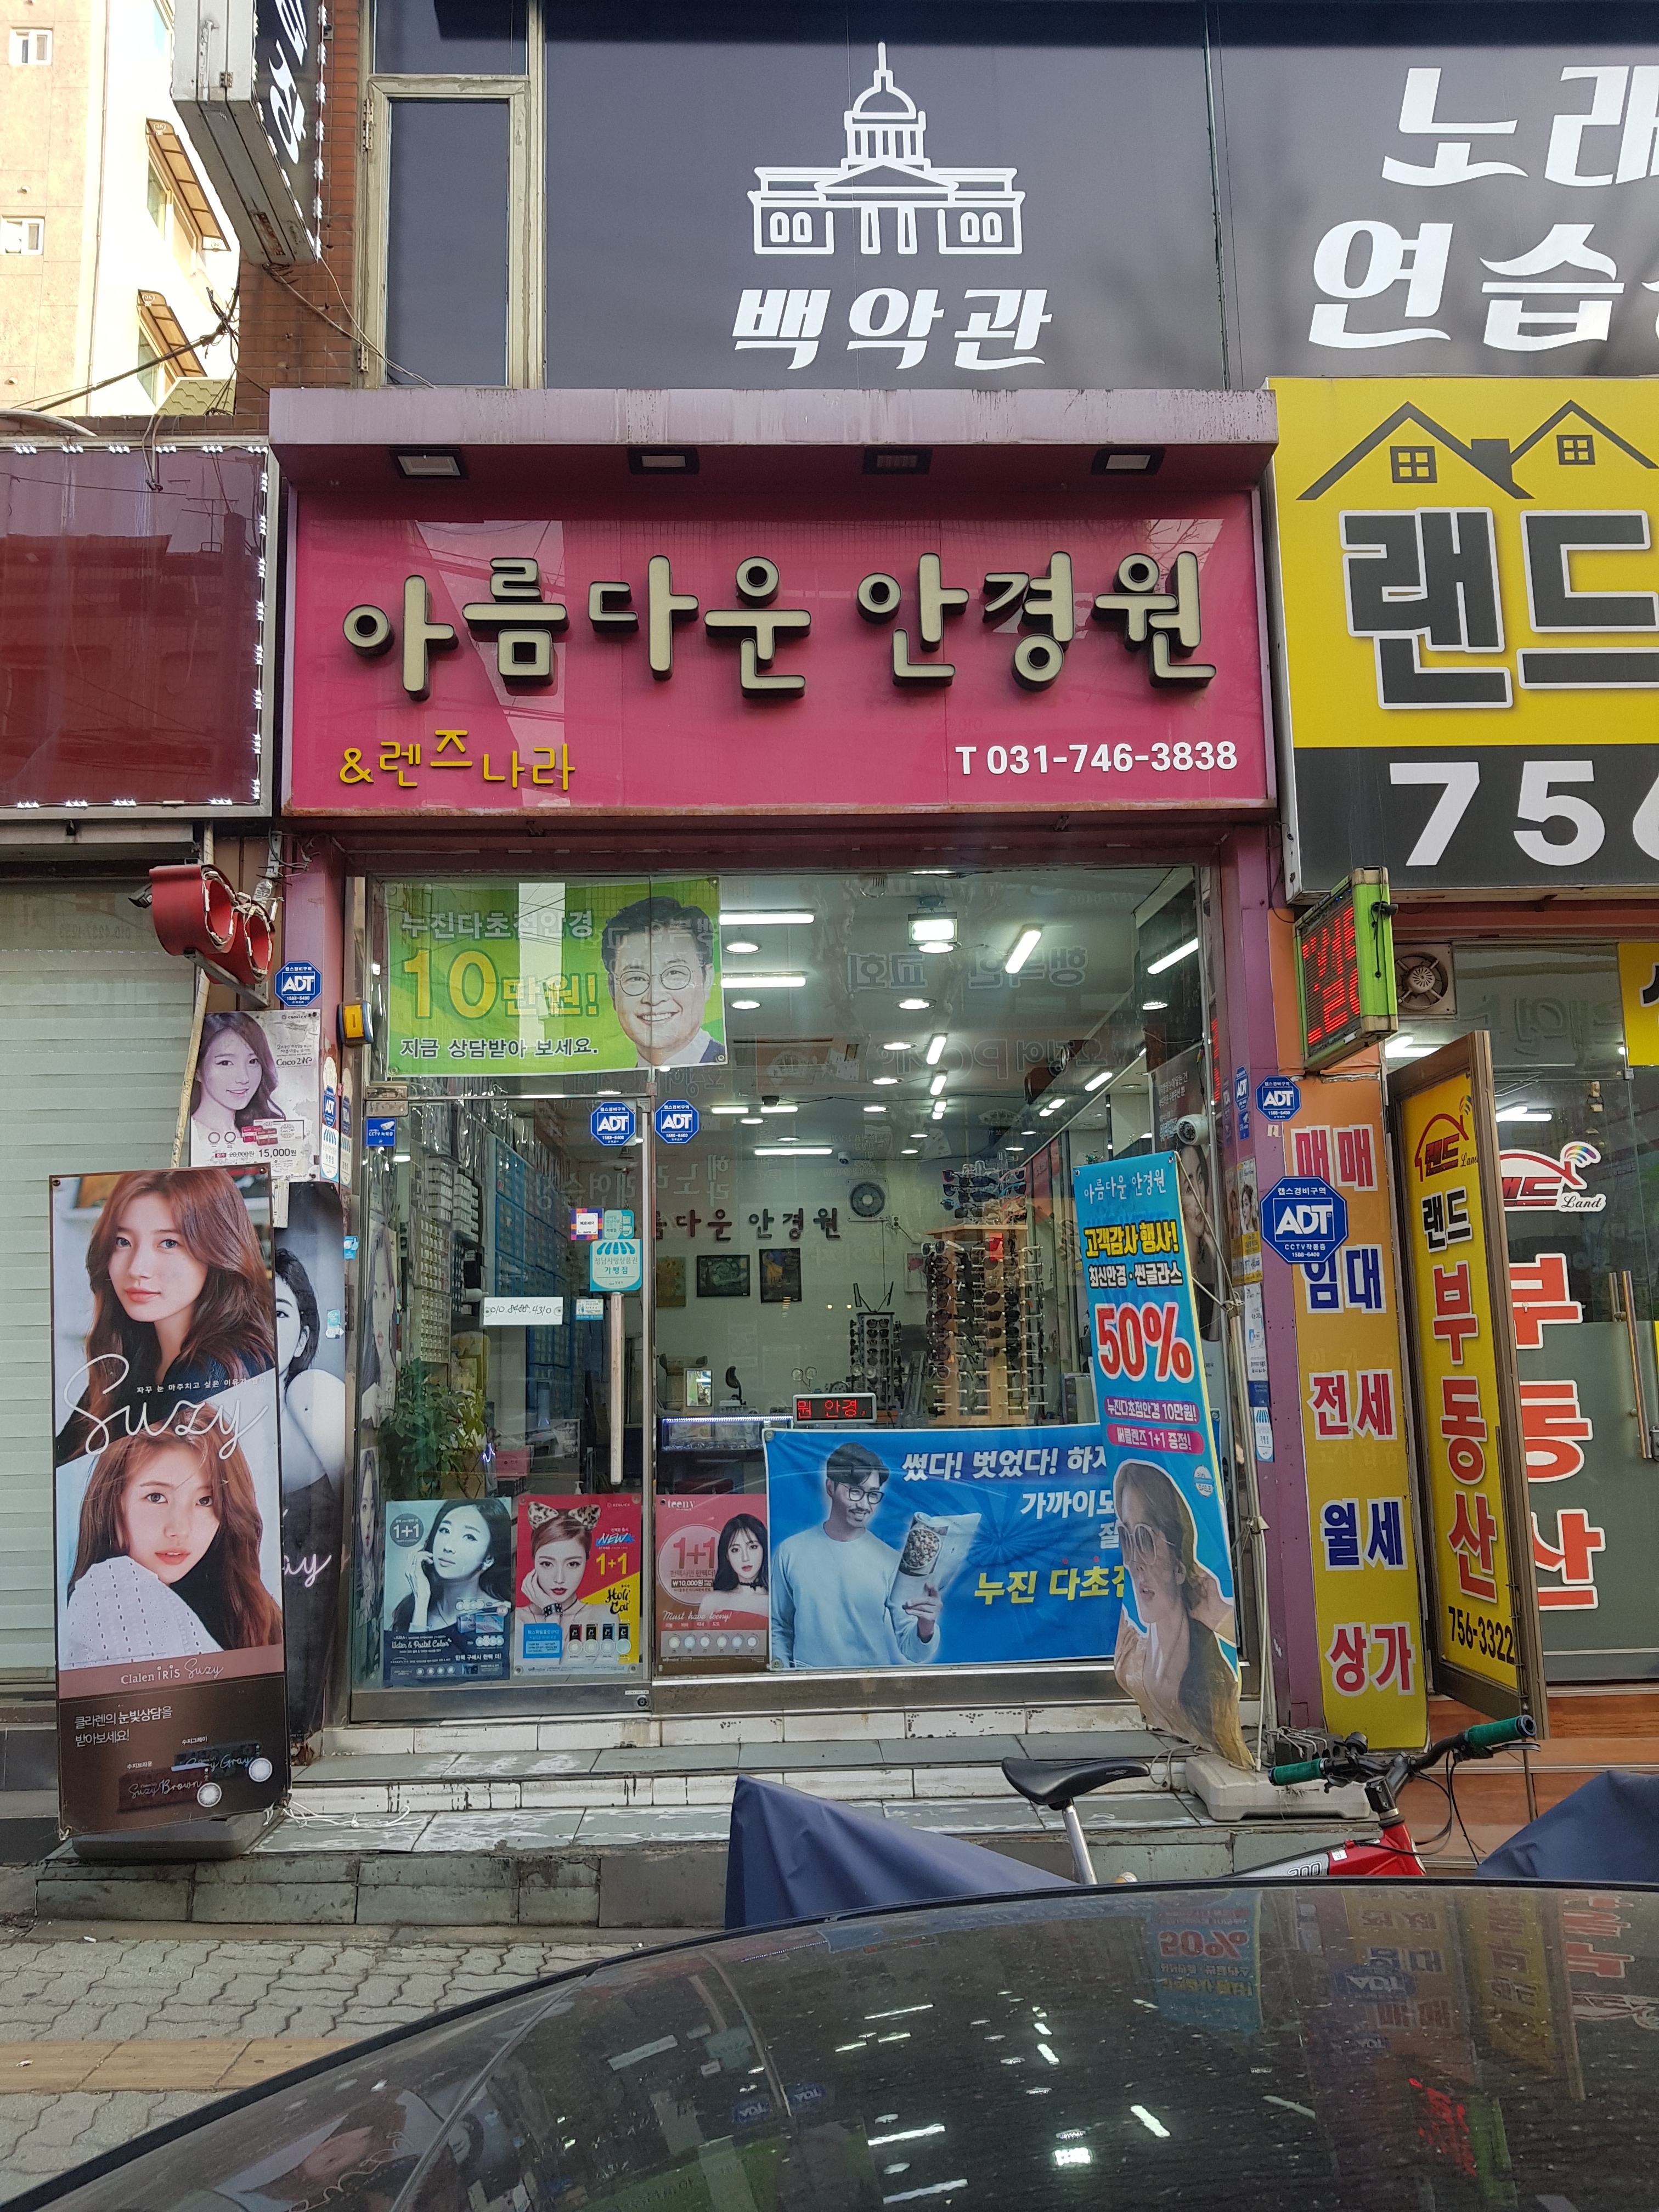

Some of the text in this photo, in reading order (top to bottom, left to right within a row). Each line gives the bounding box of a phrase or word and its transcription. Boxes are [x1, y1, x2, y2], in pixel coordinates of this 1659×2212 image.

[1309, 220, 1659, 352] 연습
[732, 288, 1053, 370] 백악관
[1339, 506, 1659, 708] 랜드
[343, 551, 1217, 701] 아름다운 안경원
[955, 741, 1238, 775] T 031-746-3838
[283, 975, 314, 992] ADT
[403, 950, 599, 1019] 10만원!
[401, 1037, 599, 1058] 지금 상담받아 보세요.
[1236, 1078, 1247, 1099] ADT
[1263, 1090, 1293, 1107] ADT
[598, 1115, 629, 1131] ADT
[662, 1114, 692, 1129] ADT
[258, 1148, 297, 1158] 15,000원
[1293, 1125, 1376, 1190] 매매
[1425, 1133, 1460, 1177] 랜드
[1084, 1168, 1166, 1205] 아름다운 안경원
[1278, 1187, 1326, 1195] 캡스경비구역
[1561, 1195, 1602, 1209] Land
[748, 1207, 841, 1240] 안경원
[1276, 1205, 1333, 1234] ADT
[1421, 1186, 1472, 1253] 랜드
[1084, 1218, 1180, 1258] 고객감사 행사!
[604, 1266, 628, 1274] 가맹점
[1302, 1245, 1385, 1312] 임대
[1094, 1302, 1195, 1384] 50%
[137, 1386, 153, 1394] 자꾸
[168, 1383, 200, 1391] 마주치고
[64, 1353, 268, 1459] Suzy
[797, 1400, 812, 1419] 원
[1107, 1397, 1197, 1422] 누진다초점안경 10만원!
[1309, 1370, 1396, 1438] 전세
[1148, 1430, 1166, 1449] 1+1
[1168, 1430, 1192, 1451] 증정!
[1432, 1260, 1497, 1604] 부동산
[901, 1451, 962, 1482] 썼다!
[972, 1447, 1058, 1479] 벗었다!
[667, 1498, 696, 1509] teeny
[393, 1523, 419, 1538] 1+1
[599, 1532, 628, 1544] NEW
[1322, 1497, 1406, 1570] 월세
[596, 1553, 627, 1575] 1+1
[673, 1537, 715, 1569] 1+1
[974, 1570, 1037, 1605] 누진
[663, 1610, 685, 1621] Must
[687, 1610, 706, 1621] have
[413, 1639, 432, 1649] Pastel
[432, 1639, 450, 1647] Color
[1448, 1605, 1515, 1667] 756-3322
[120, 1672, 155, 1685] Clalen
[184, 1657, 224, 1679] Suzy
[1328, 1623, 1414, 1695] 상가
[74, 1705, 173, 1729] 클라렌의 눈빛상담을
[75, 1729, 129, 1747] 받아보세요!
[159, 1779, 202, 1795] Brown
